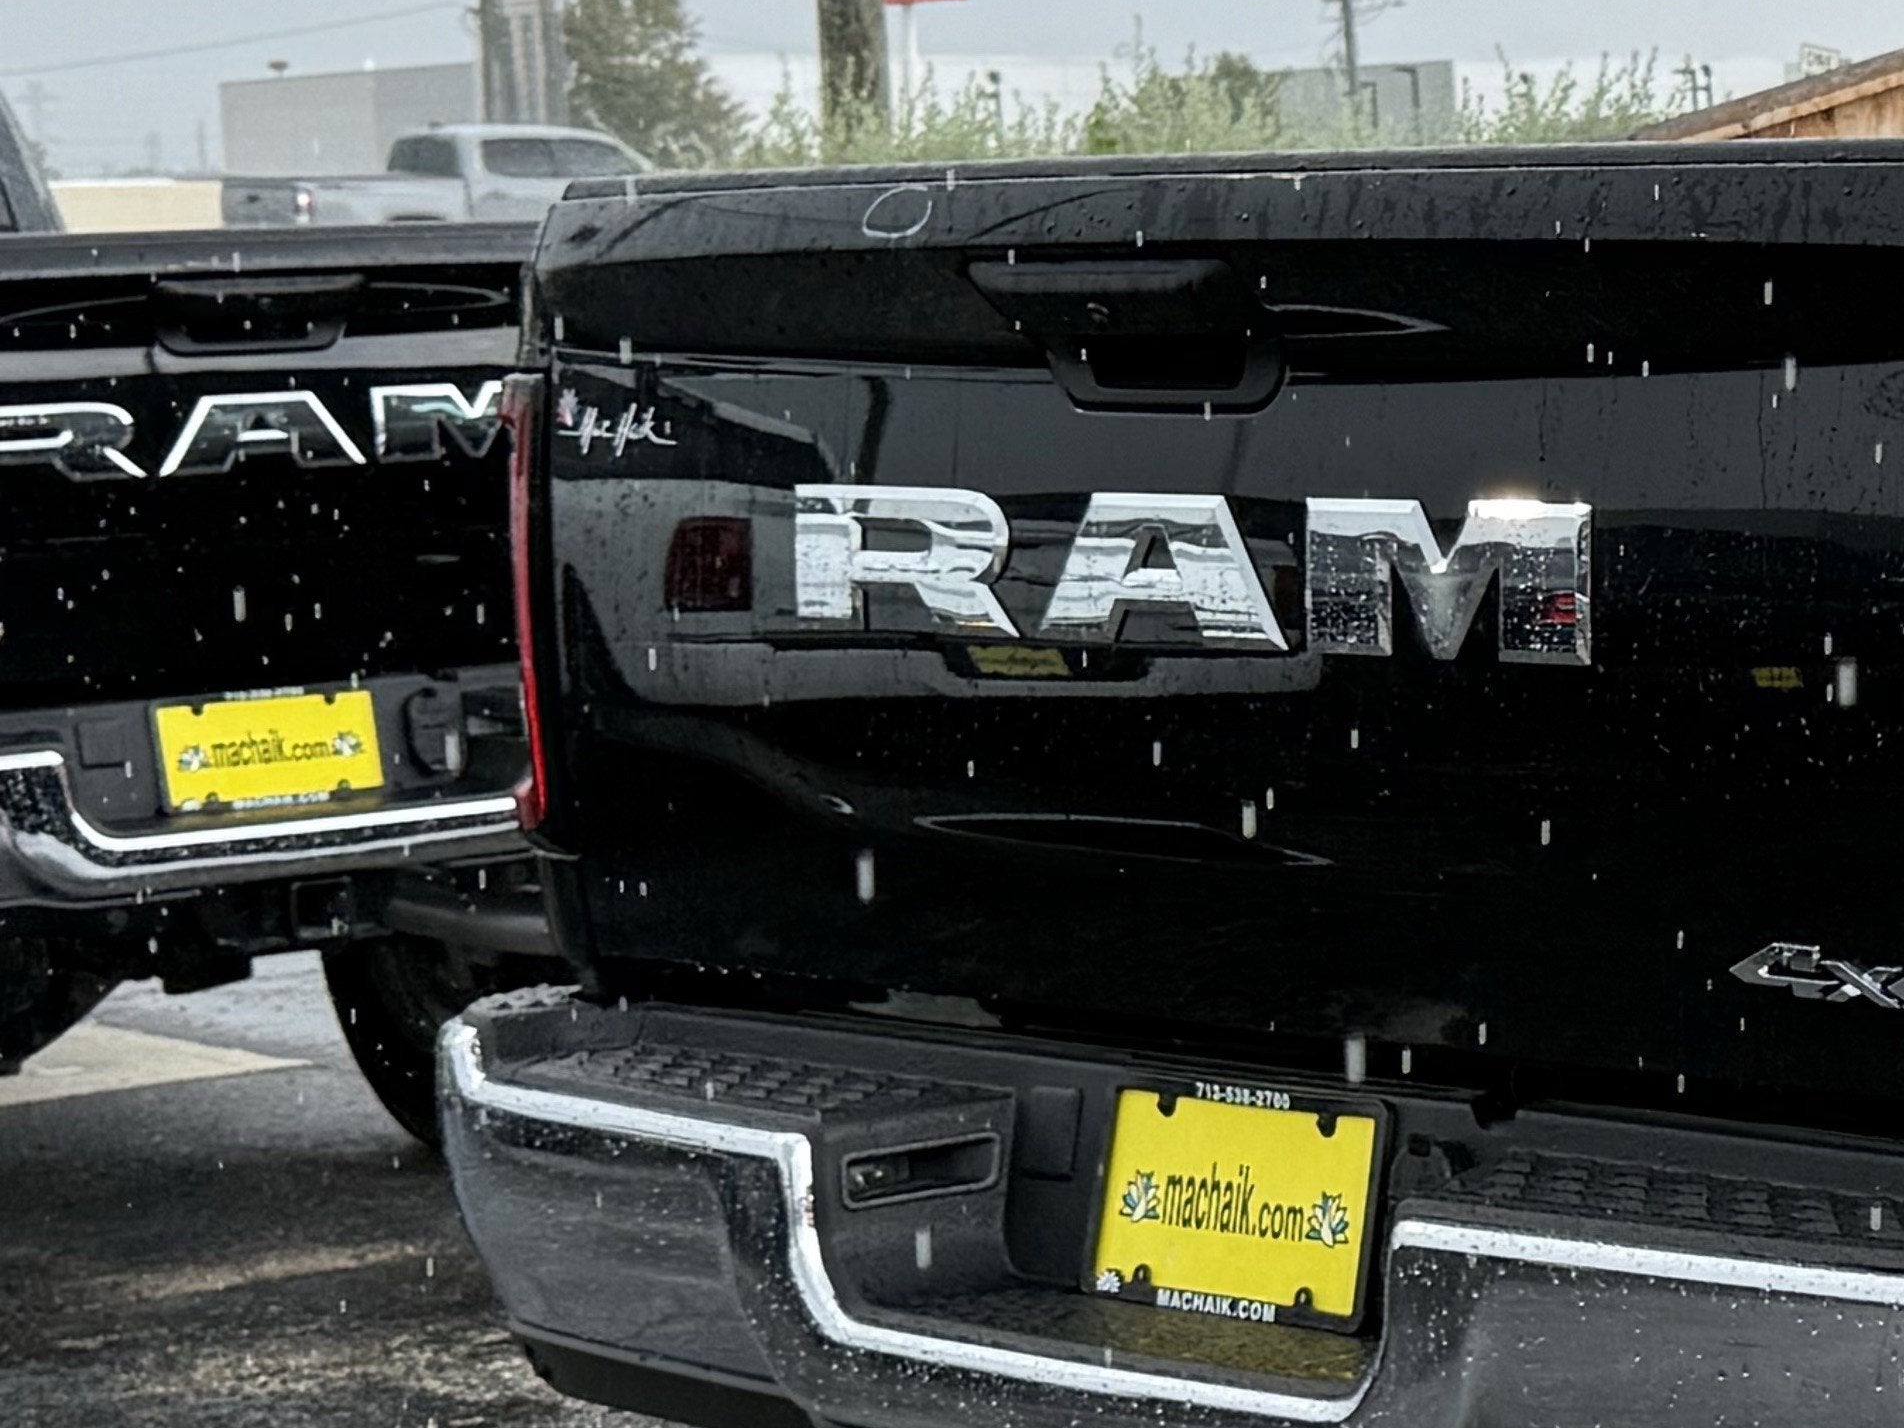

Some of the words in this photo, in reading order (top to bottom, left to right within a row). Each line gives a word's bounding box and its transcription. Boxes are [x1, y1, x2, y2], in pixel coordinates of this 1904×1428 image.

[0, 379, 512, 482] RAM
[794, 482, 1593, 666] RAM
[1160, 1162, 1305, 1242] machaik.com
[1156, 1288, 1276, 1324] MACHAIK.COM
